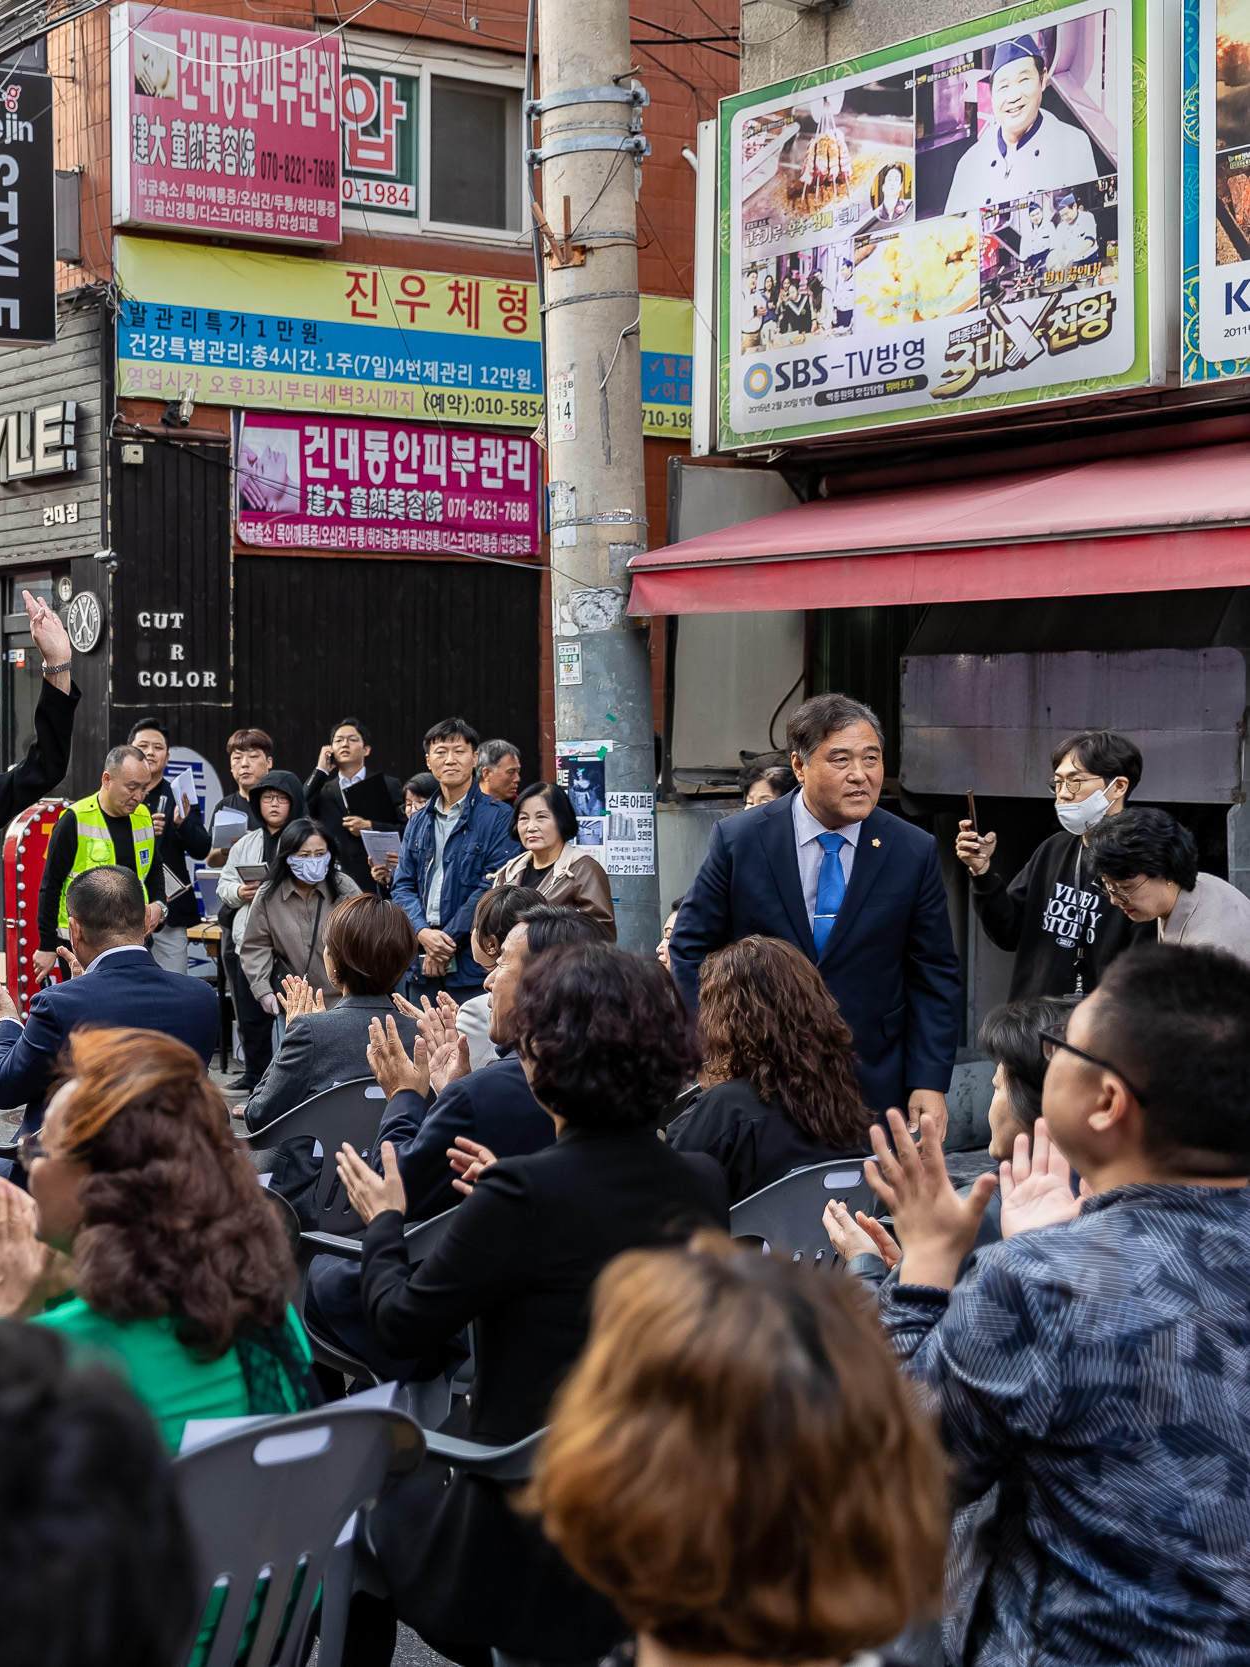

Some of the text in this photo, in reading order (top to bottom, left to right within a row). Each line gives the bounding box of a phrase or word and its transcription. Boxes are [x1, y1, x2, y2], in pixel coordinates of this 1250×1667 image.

[180, 28, 337, 132] 건대동안피부관리
[261, 151, 336, 189] 070-8221-7688
[1048, 293, 1113, 350] 천왕
[304, 425, 531, 491] 건대동안피부관리
[447, 498, 530, 523] 070-8221-7688
[138, 612, 184, 630] CUT
[138, 671, 217, 687] COLOR
